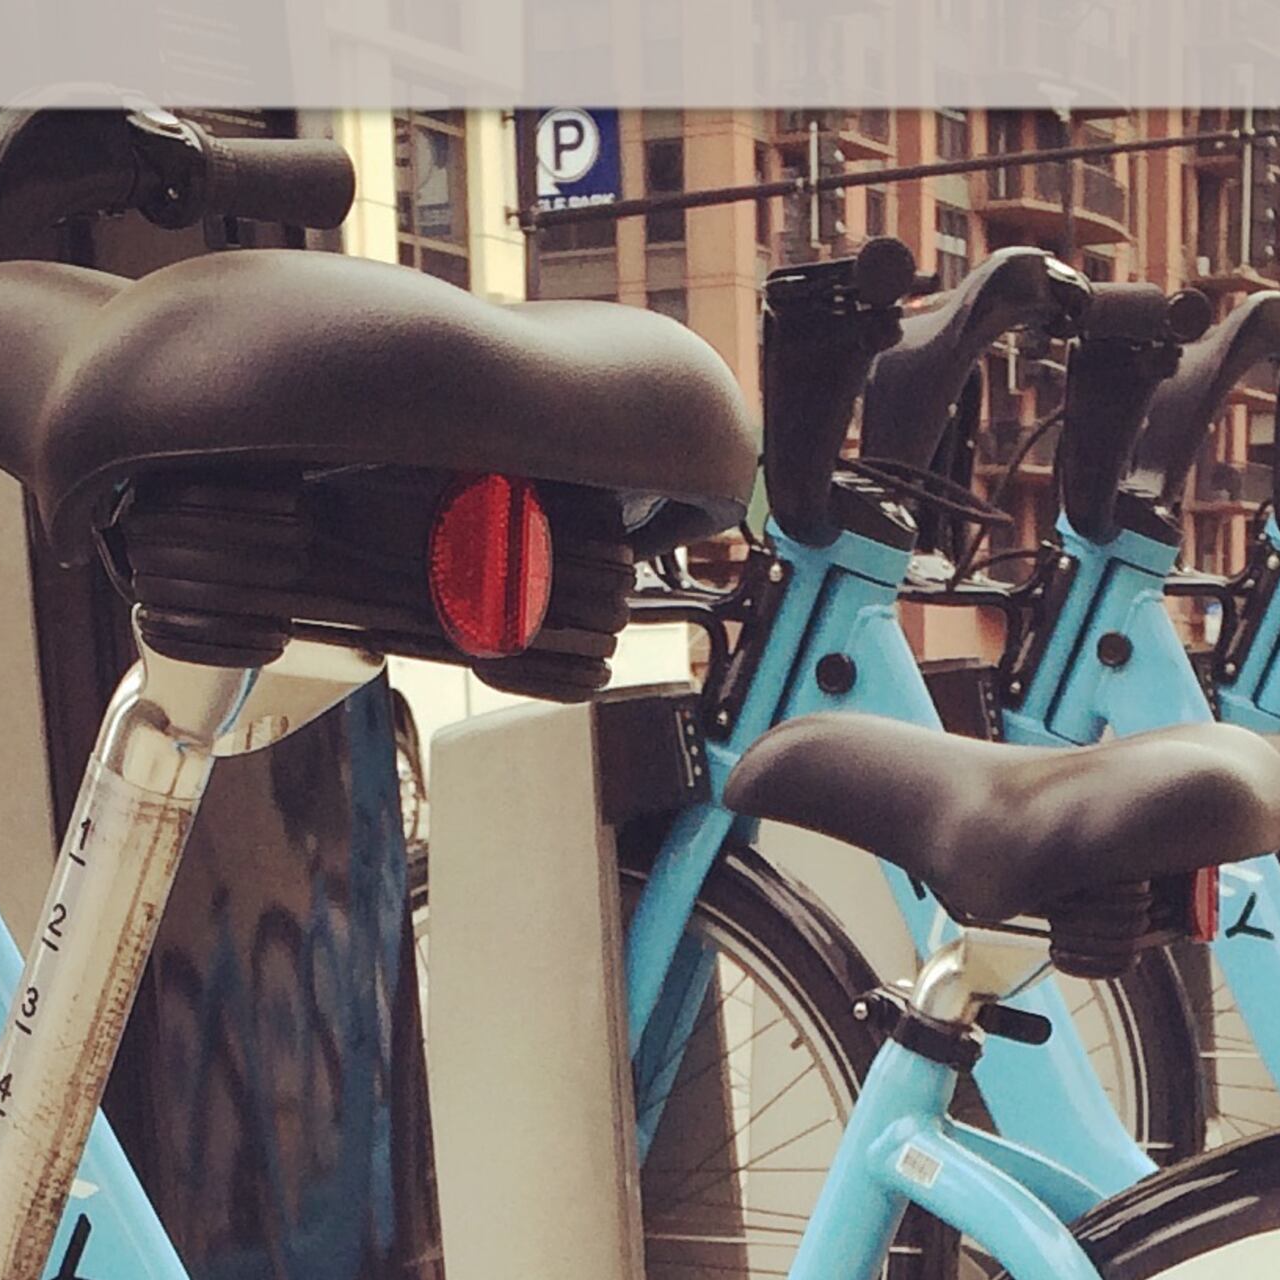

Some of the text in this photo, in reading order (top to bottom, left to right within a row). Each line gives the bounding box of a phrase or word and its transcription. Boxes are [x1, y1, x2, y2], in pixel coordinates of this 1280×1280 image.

[553, 119, 585, 171] P
[79, 818, 93, 851] 1
[49, 903, 69, 938] 2
[21, 987, 39, 1020] 3
